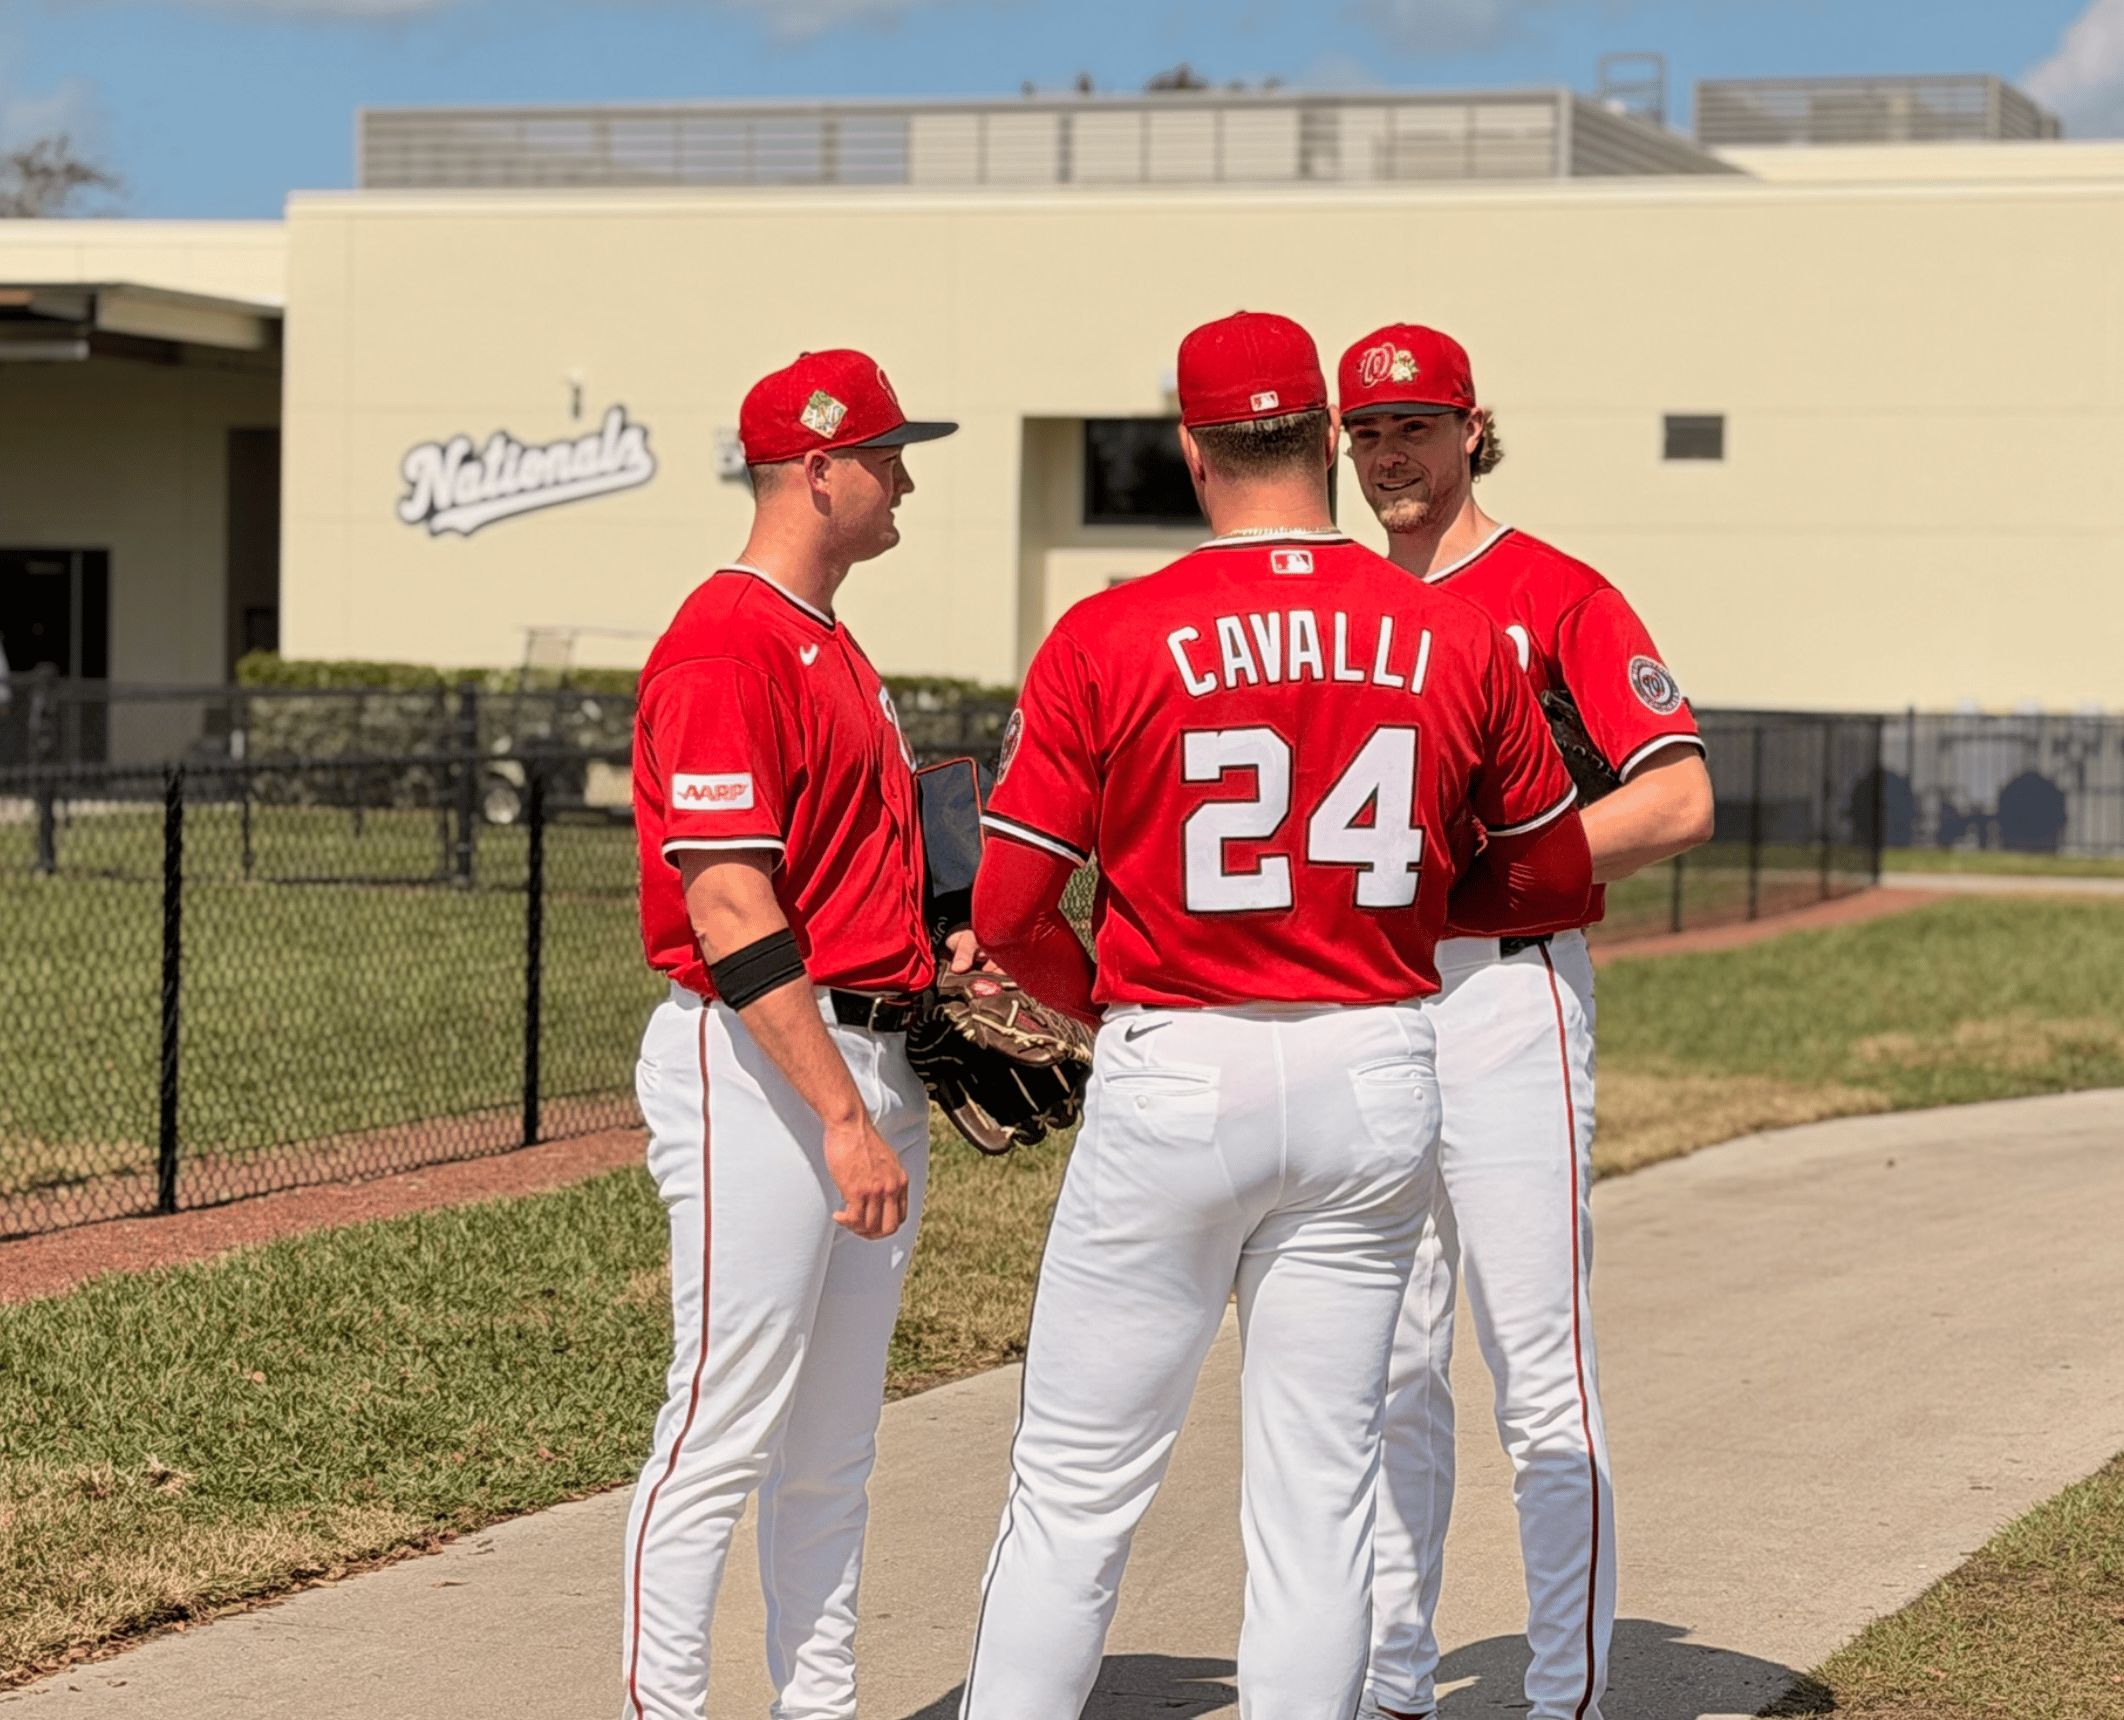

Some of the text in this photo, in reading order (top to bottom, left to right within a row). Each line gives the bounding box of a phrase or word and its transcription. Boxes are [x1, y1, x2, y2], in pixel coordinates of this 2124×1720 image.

[397, 403, 655, 526] Nationals
[1166, 609, 1433, 698] CAVALLI
[677, 783, 749, 802] AARP
[1182, 725, 1424, 914] 24
